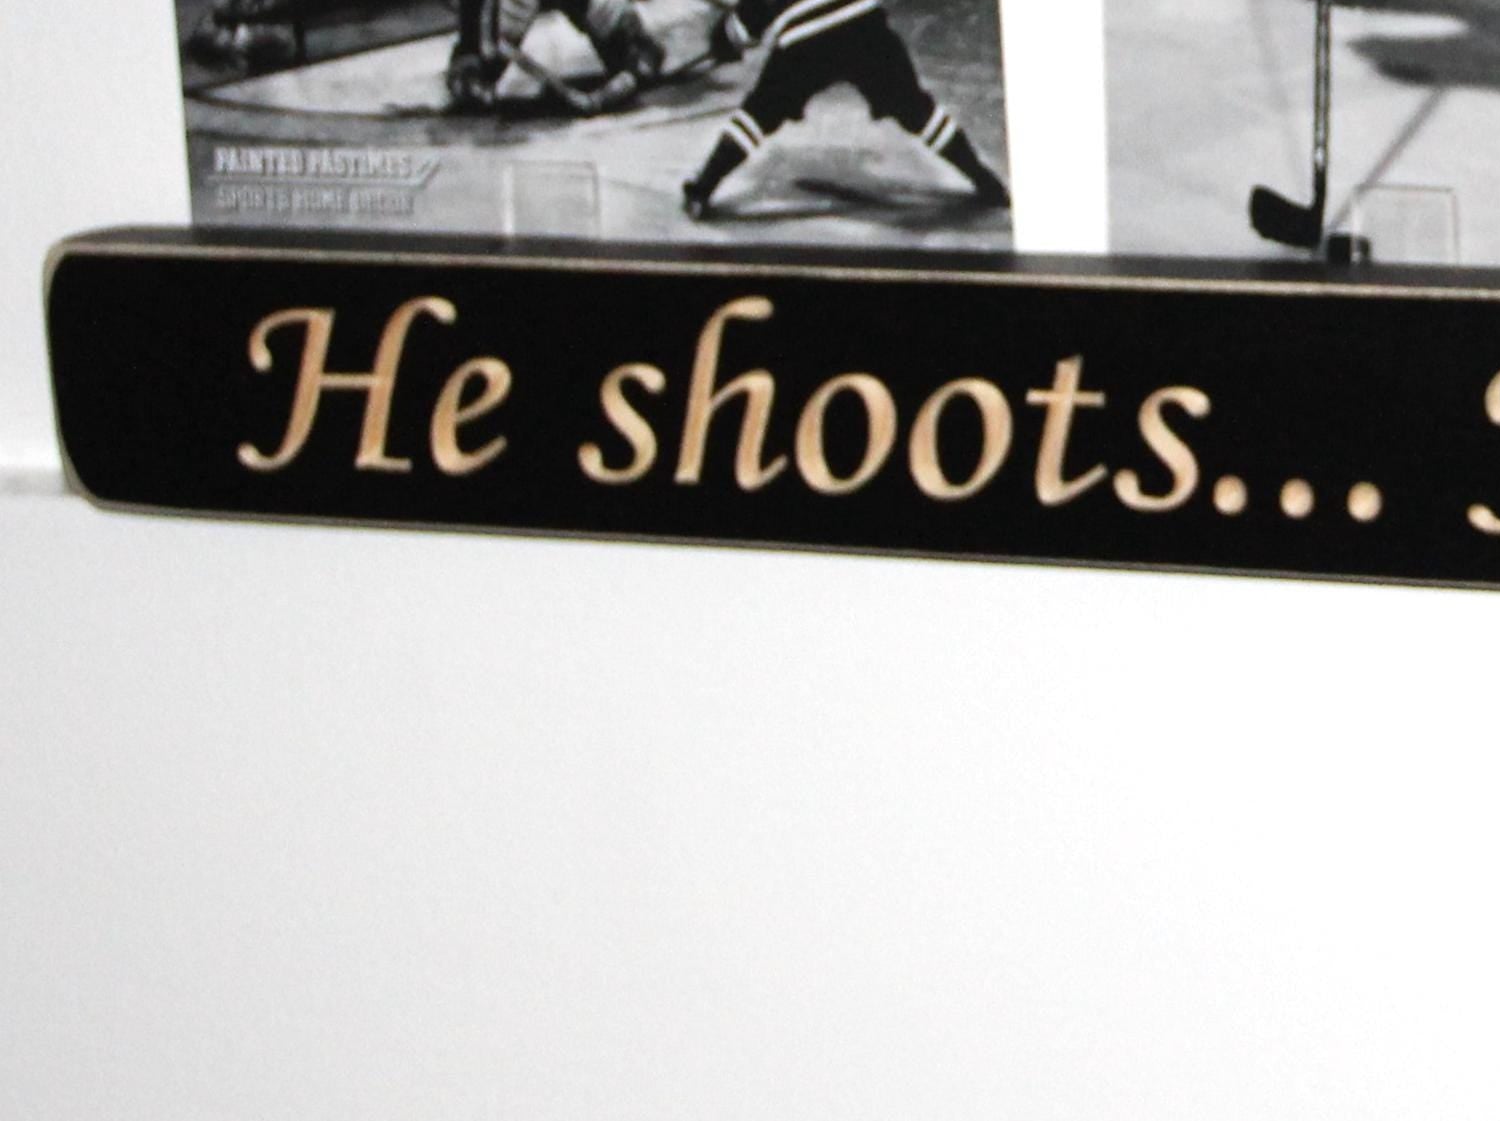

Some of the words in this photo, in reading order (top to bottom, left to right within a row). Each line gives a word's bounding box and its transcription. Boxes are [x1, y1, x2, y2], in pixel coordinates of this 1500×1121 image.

[213, 147, 306, 175] PAINTED
[238, 297, 512, 475] He
[577, 297, 1385, 521] shoots...
